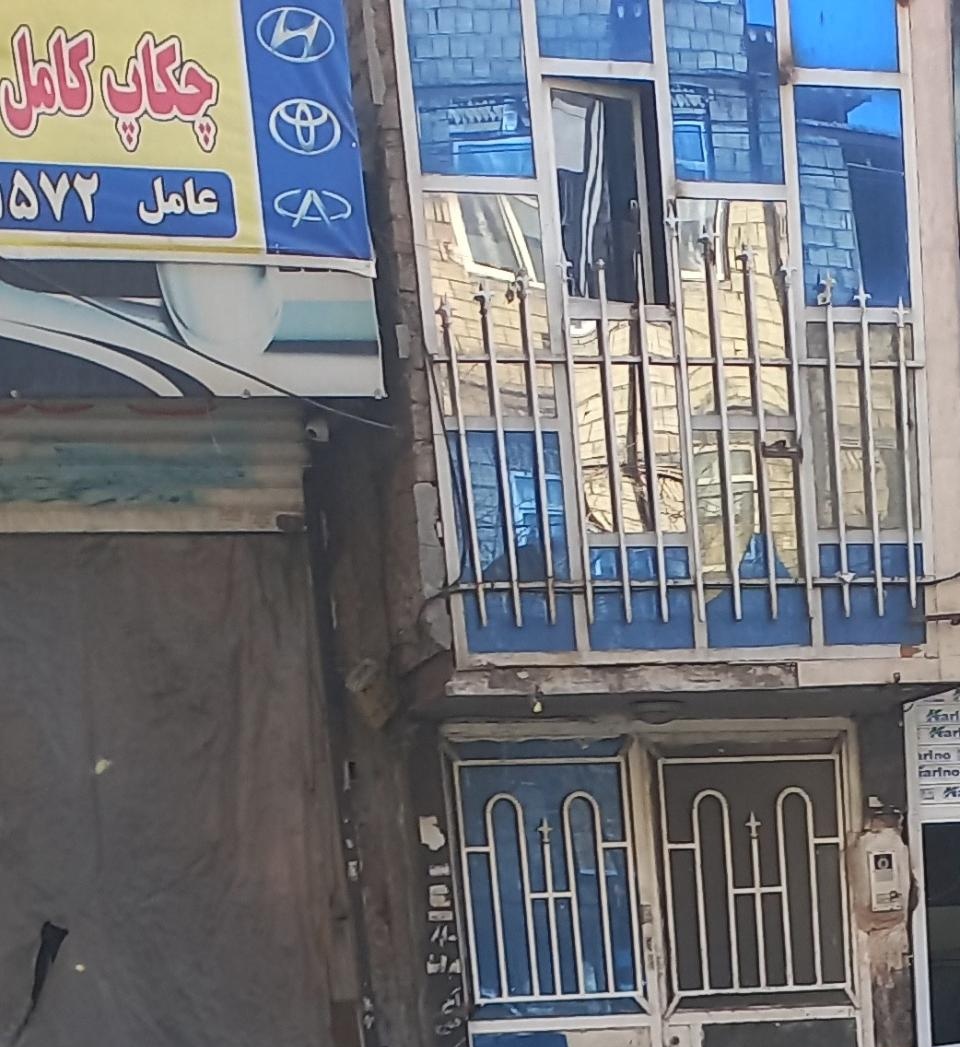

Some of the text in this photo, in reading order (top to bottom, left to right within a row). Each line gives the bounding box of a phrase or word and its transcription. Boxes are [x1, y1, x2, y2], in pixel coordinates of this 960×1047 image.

[0, 24, 219, 152] چکاپ کامل
[0, 169, 99, 222] ۵۷۲
[139, 176, 219, 225] عامل
